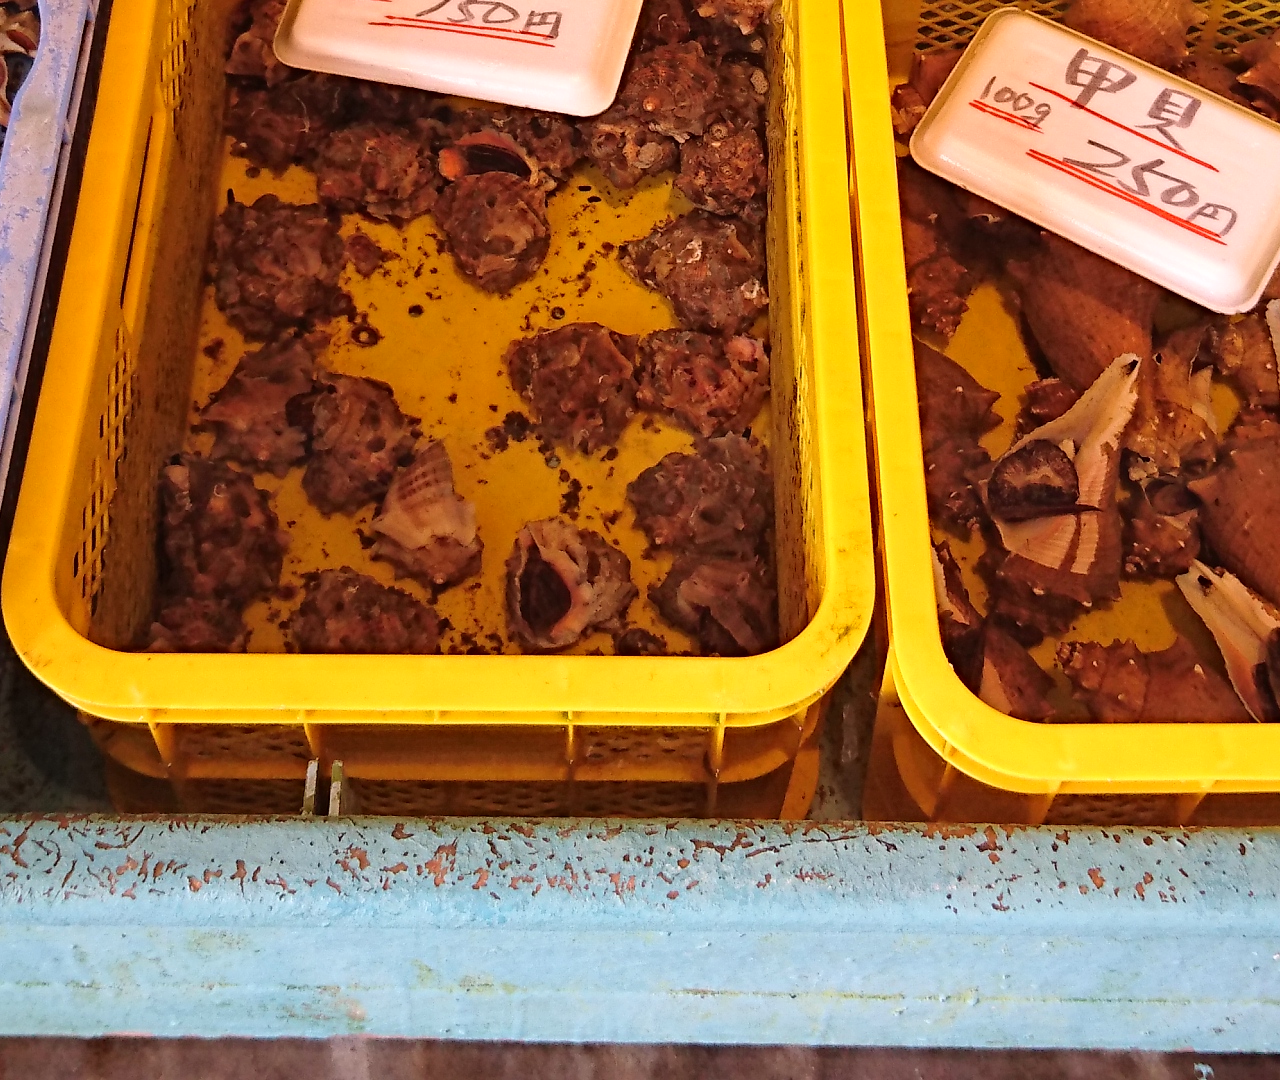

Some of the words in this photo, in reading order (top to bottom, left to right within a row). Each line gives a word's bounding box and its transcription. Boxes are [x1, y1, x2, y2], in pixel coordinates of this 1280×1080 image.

[979, 75, 1051, 128] 100g
[1065, 47, 1202, 152] 甲貝
[1062, 140, 1238, 237] 250円
